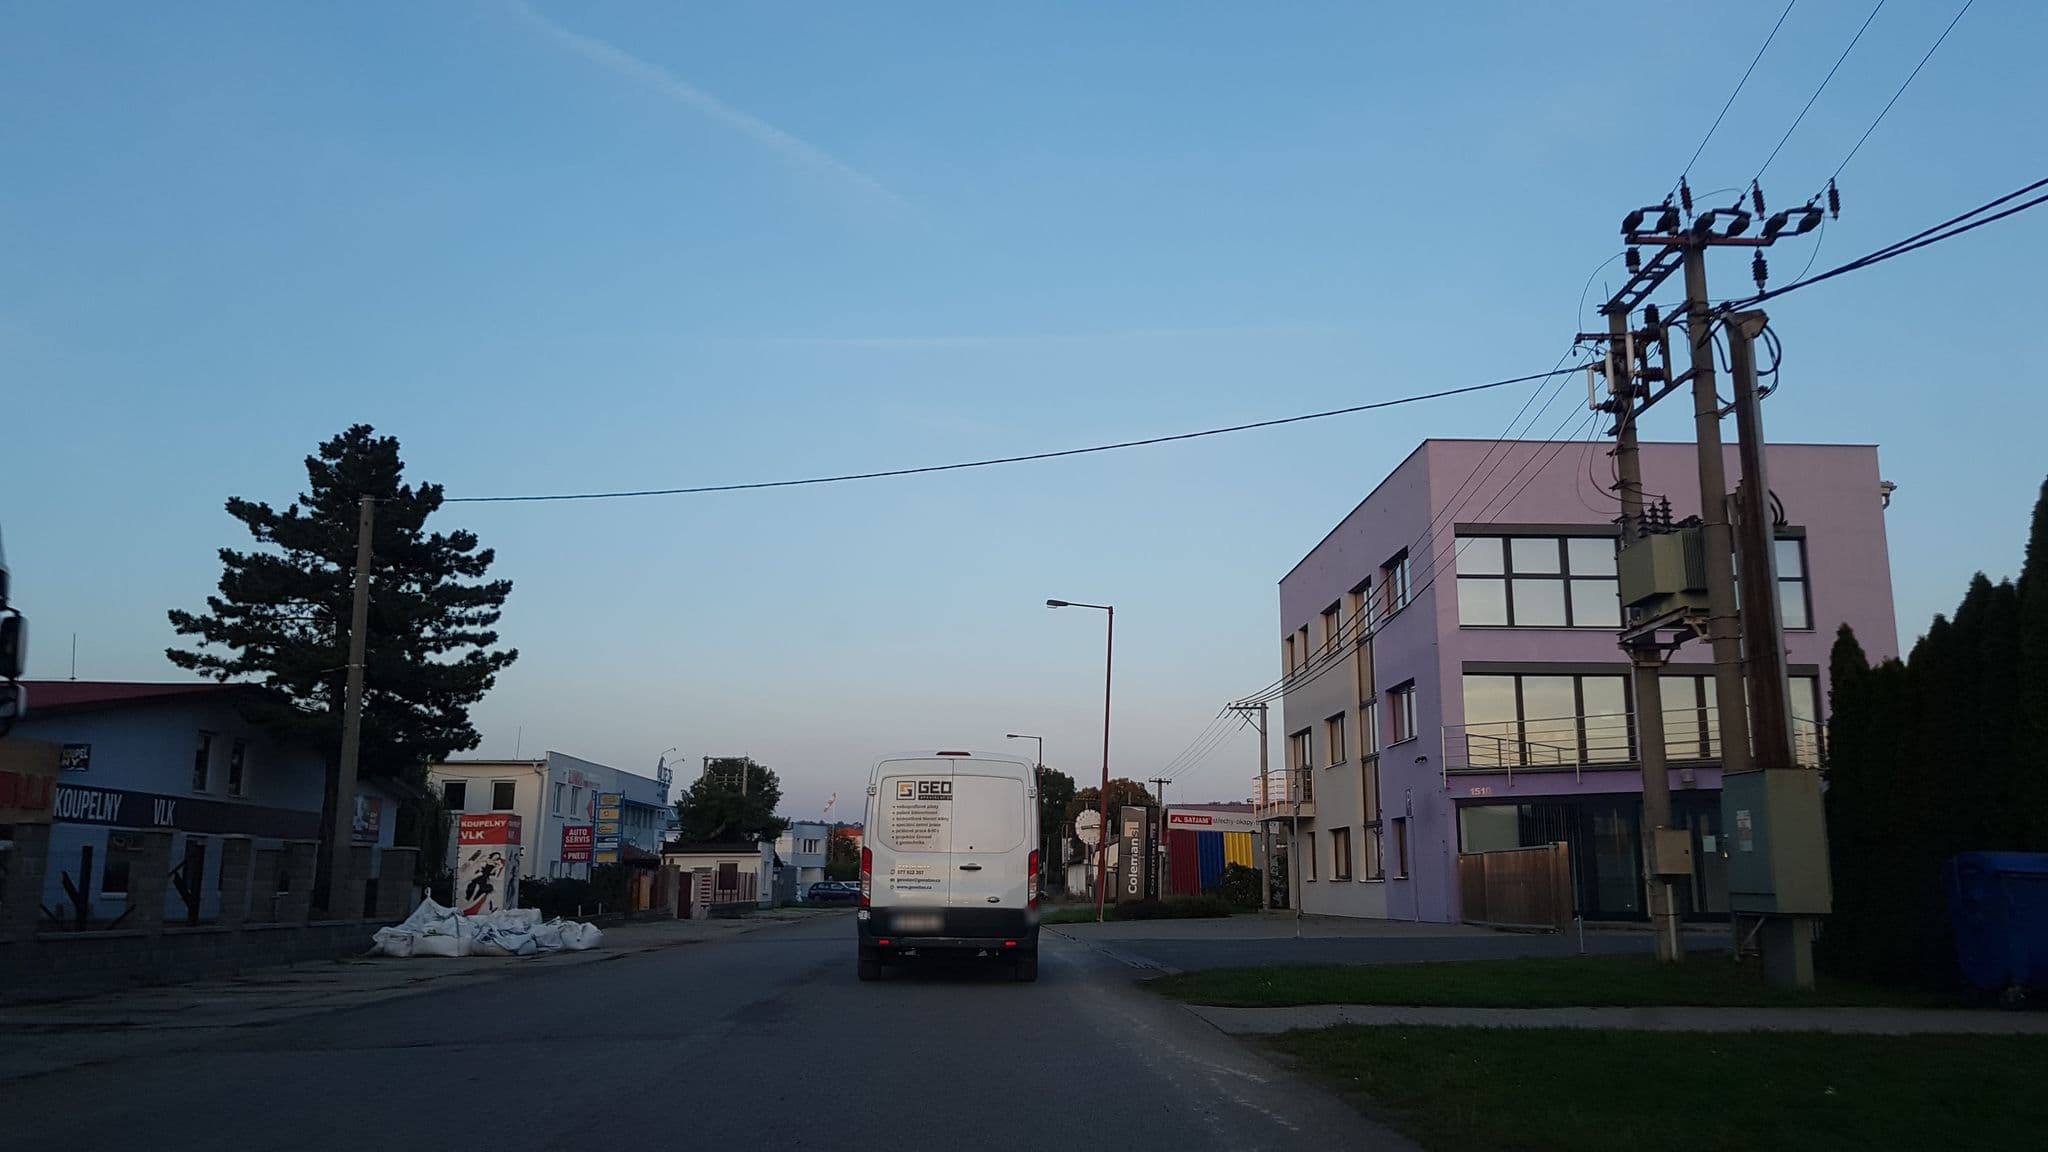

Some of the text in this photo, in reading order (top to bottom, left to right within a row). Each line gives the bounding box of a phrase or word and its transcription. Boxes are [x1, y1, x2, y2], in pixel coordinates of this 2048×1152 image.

[918, 781, 952, 794] GEO
[54, 787, 122, 821] KOUPELNY
[152, 798, 177, 826] VLK
[461, 819, 507, 828] KOUPELNY
[461, 830, 485, 840] VLK
[568, 828, 588, 836] AUTO
[565, 836, 591, 844] SERVIS
